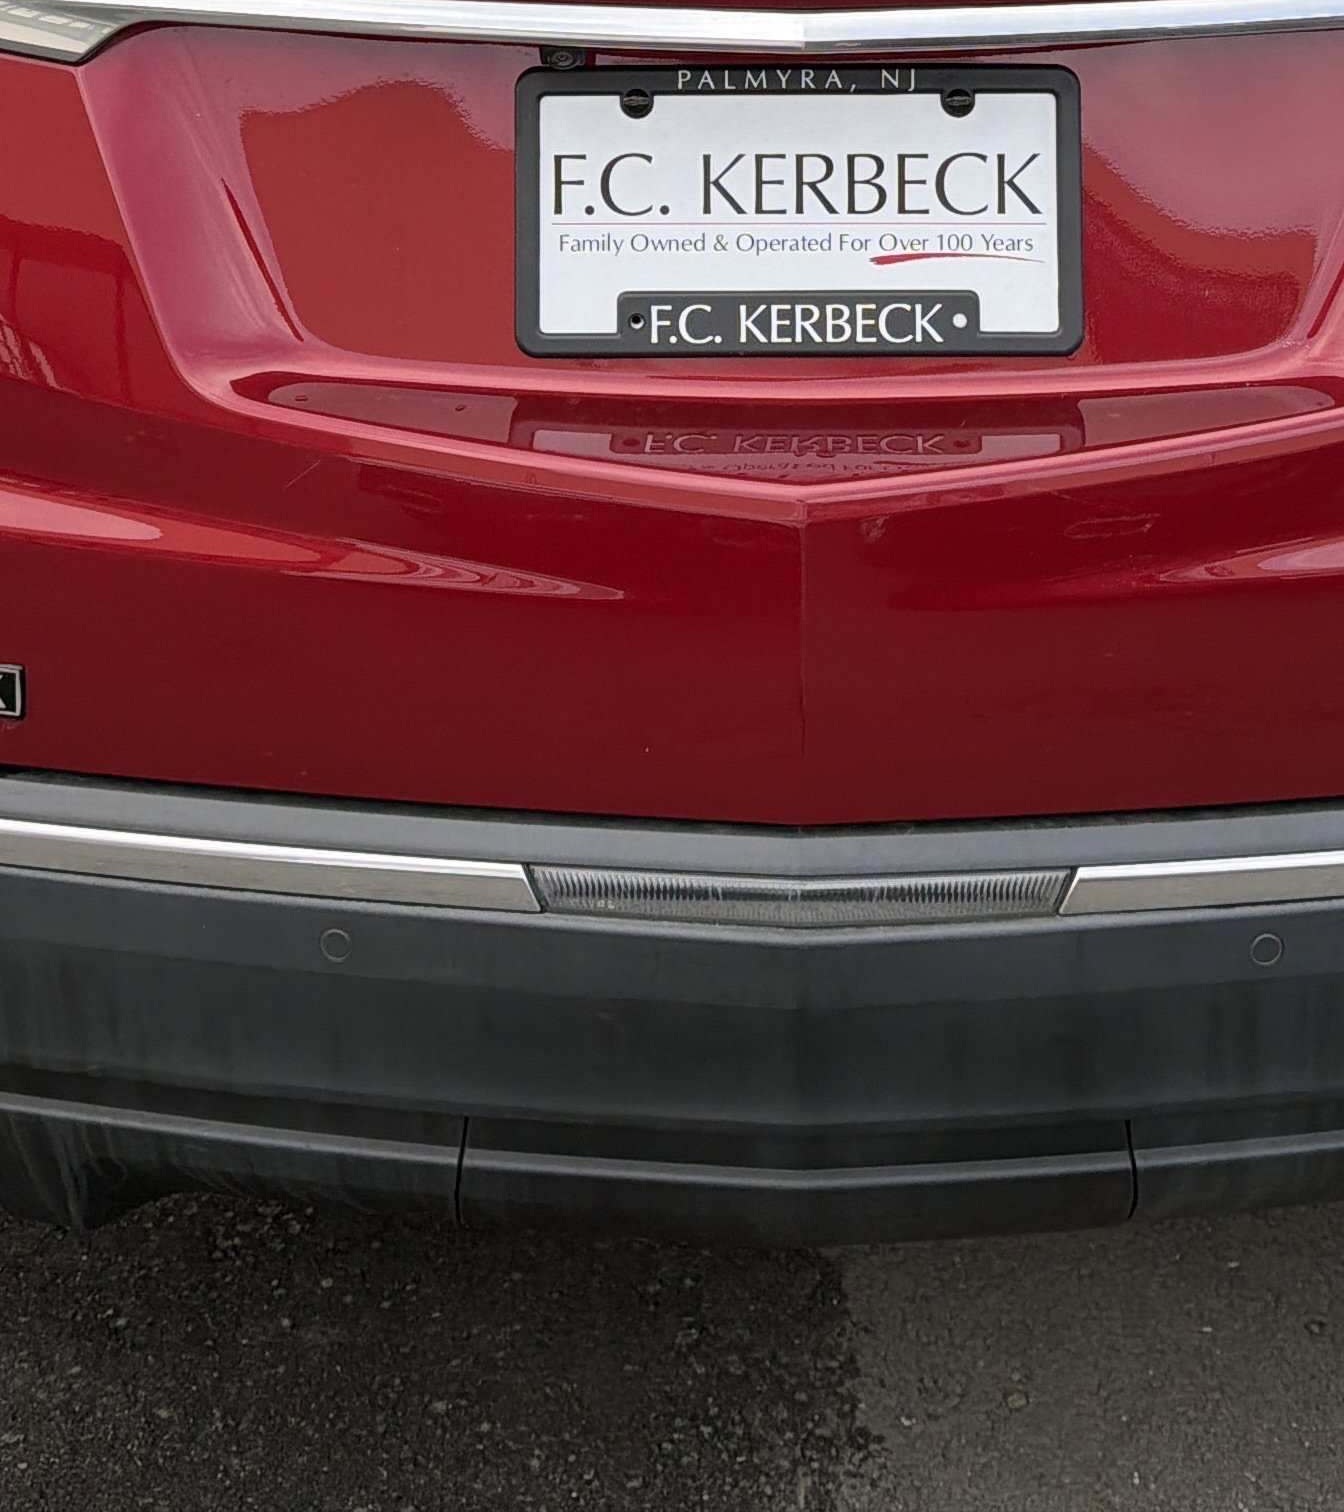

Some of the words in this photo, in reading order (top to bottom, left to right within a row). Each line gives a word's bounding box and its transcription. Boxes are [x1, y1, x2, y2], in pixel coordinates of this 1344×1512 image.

[677, 69, 857, 93] PALMYRA,
[880, 68, 917, 91] NJ
[552, 152, 671, 216] F.C.
[701, 151, 1044, 216] KERBECK
[558, 233, 625, 256] Family
[630, 232, 706, 253] Owned
[712, 233, 729, 252] &
[735, 232, 832, 256] Operated
[839, 233, 872, 252] For
[878, 232, 930, 252] Over
[936, 233, 973, 252] 100
[980, 233, 1034, 252] Years
[649, 303, 723, 345] F.C.
[738, 302, 945, 344] KERBECK
